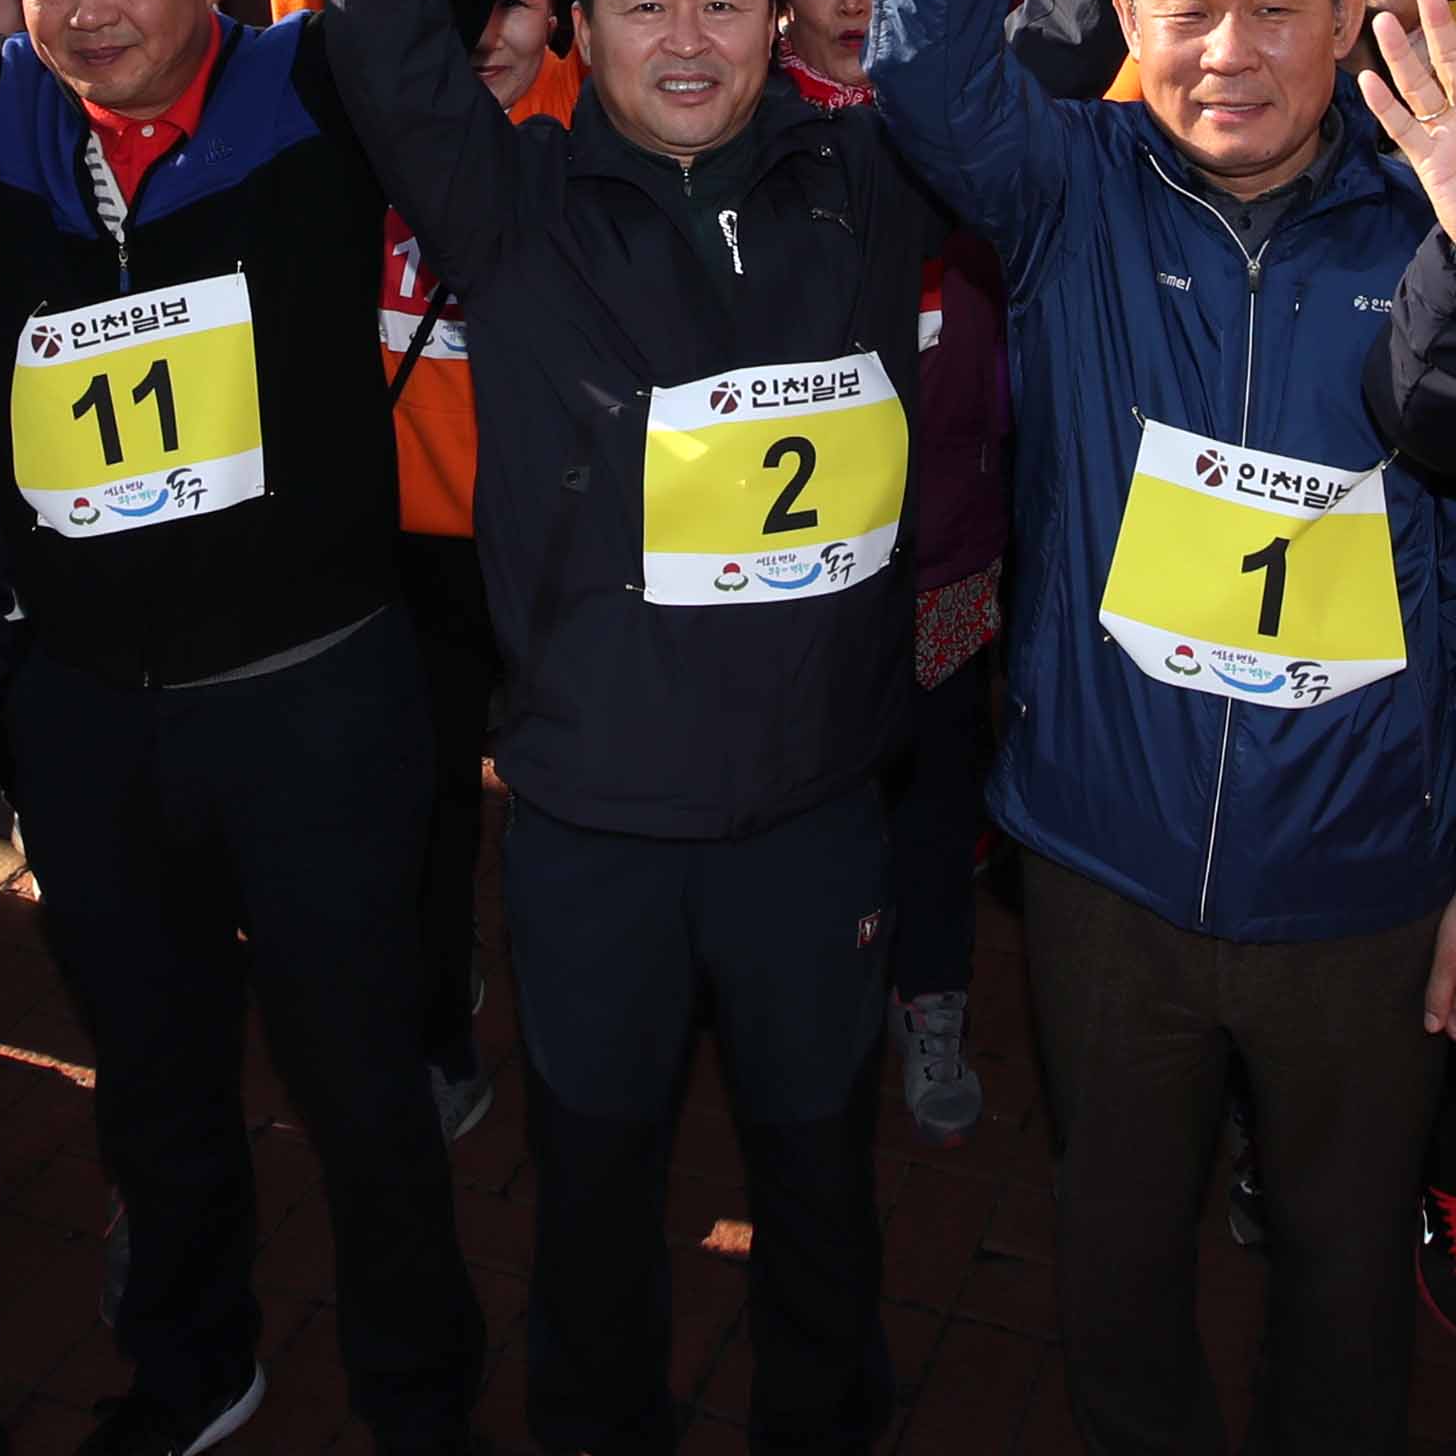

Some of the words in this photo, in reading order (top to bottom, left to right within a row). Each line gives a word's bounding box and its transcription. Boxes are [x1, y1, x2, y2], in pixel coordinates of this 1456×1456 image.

[71, 297, 191, 349] 인천일보
[751, 368, 861, 409] 인천일보
[72, 359, 179, 466] 11
[166, 468, 209, 511] 동구
[762, 436, 818, 536] 2
[820, 542, 857, 584] 동구
[1241, 537, 1291, 638] 1
[1286, 661, 1332, 704] 동구
